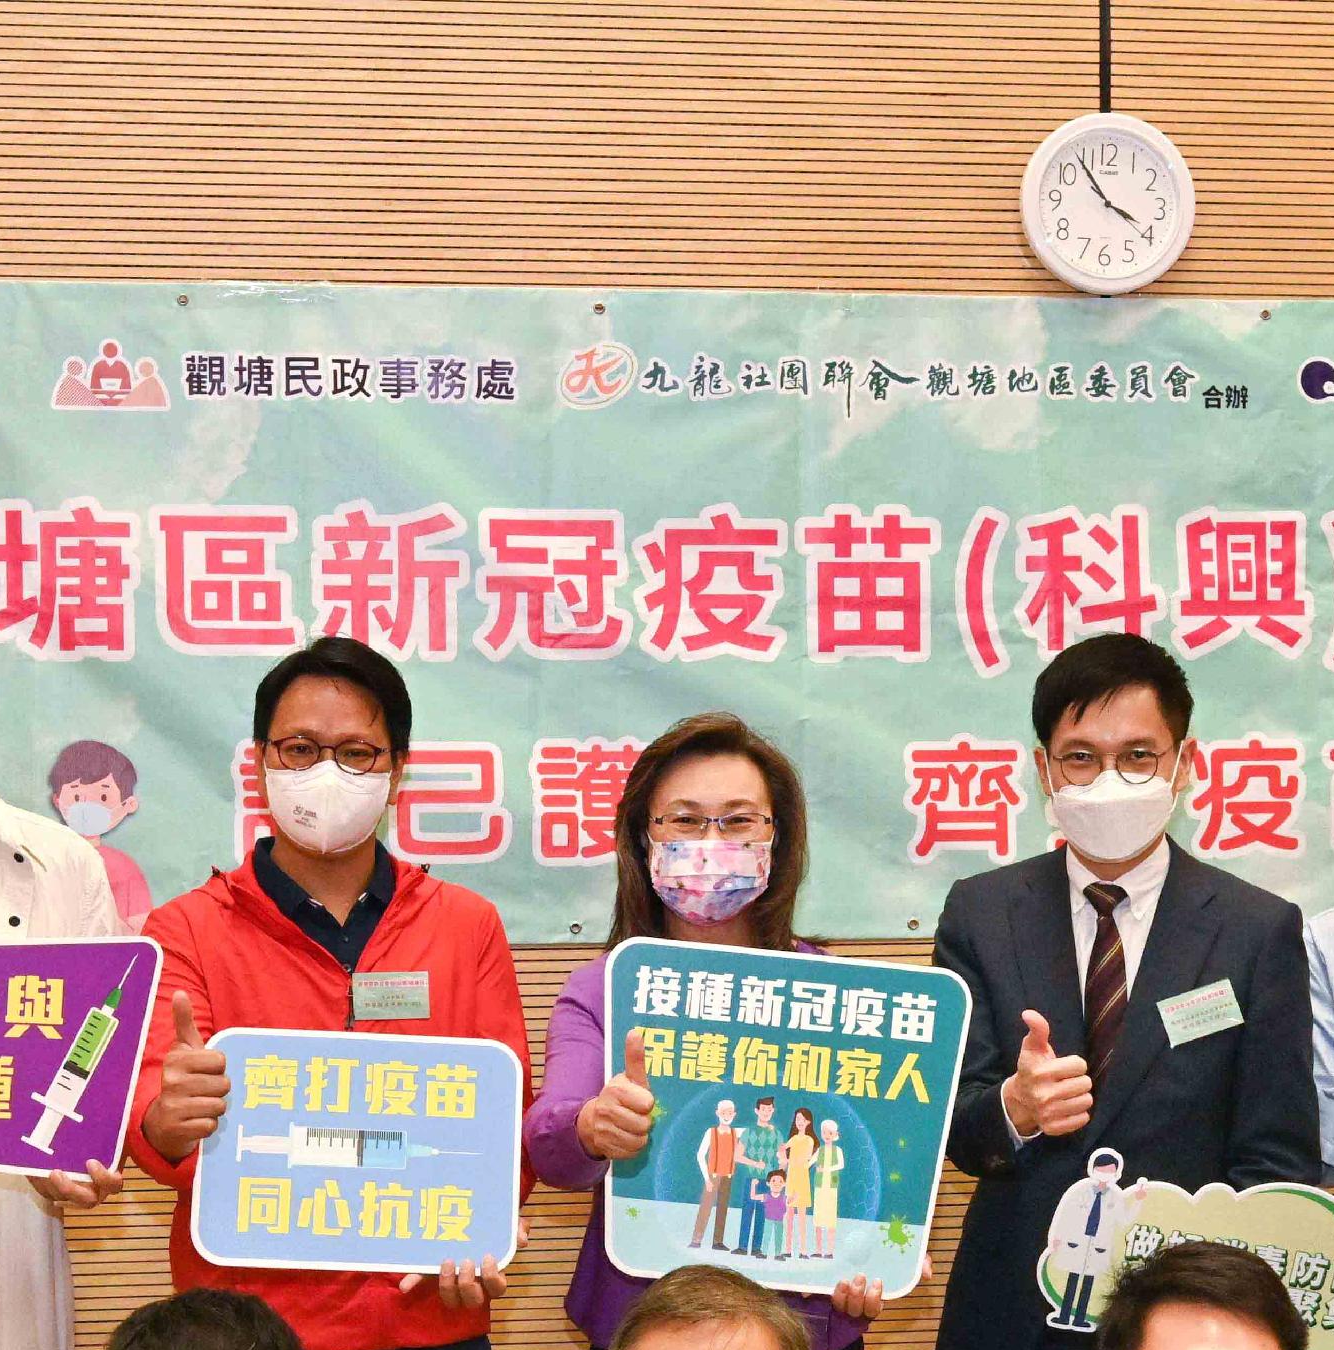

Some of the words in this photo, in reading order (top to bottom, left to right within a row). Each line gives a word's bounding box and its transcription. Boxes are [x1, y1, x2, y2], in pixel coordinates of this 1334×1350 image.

[1101, 143, 1118, 167] 12
[1059, 162, 1077, 185] 10
[1145, 168, 1157, 191] 2
[1048, 189, 1062, 211] 9
[1154, 198, 1166, 220] 3
[1056, 217, 1069, 240] 8
[1141, 225, 1154, 247] 4
[1077, 237, 1091, 259] 7
[1098, 244, 1111, 266] 6
[1122, 240, 1135, 263] 5
[184, 355, 516, 401] 觀塘民政事務處
[1202, 385, 1248, 410] 合辦
[633, 965, 938, 1043] 接種新冠疫苗
[243, 1054, 479, 1119] 齊打疫苗
[236, 1177, 474, 1242] 同心抗疫
